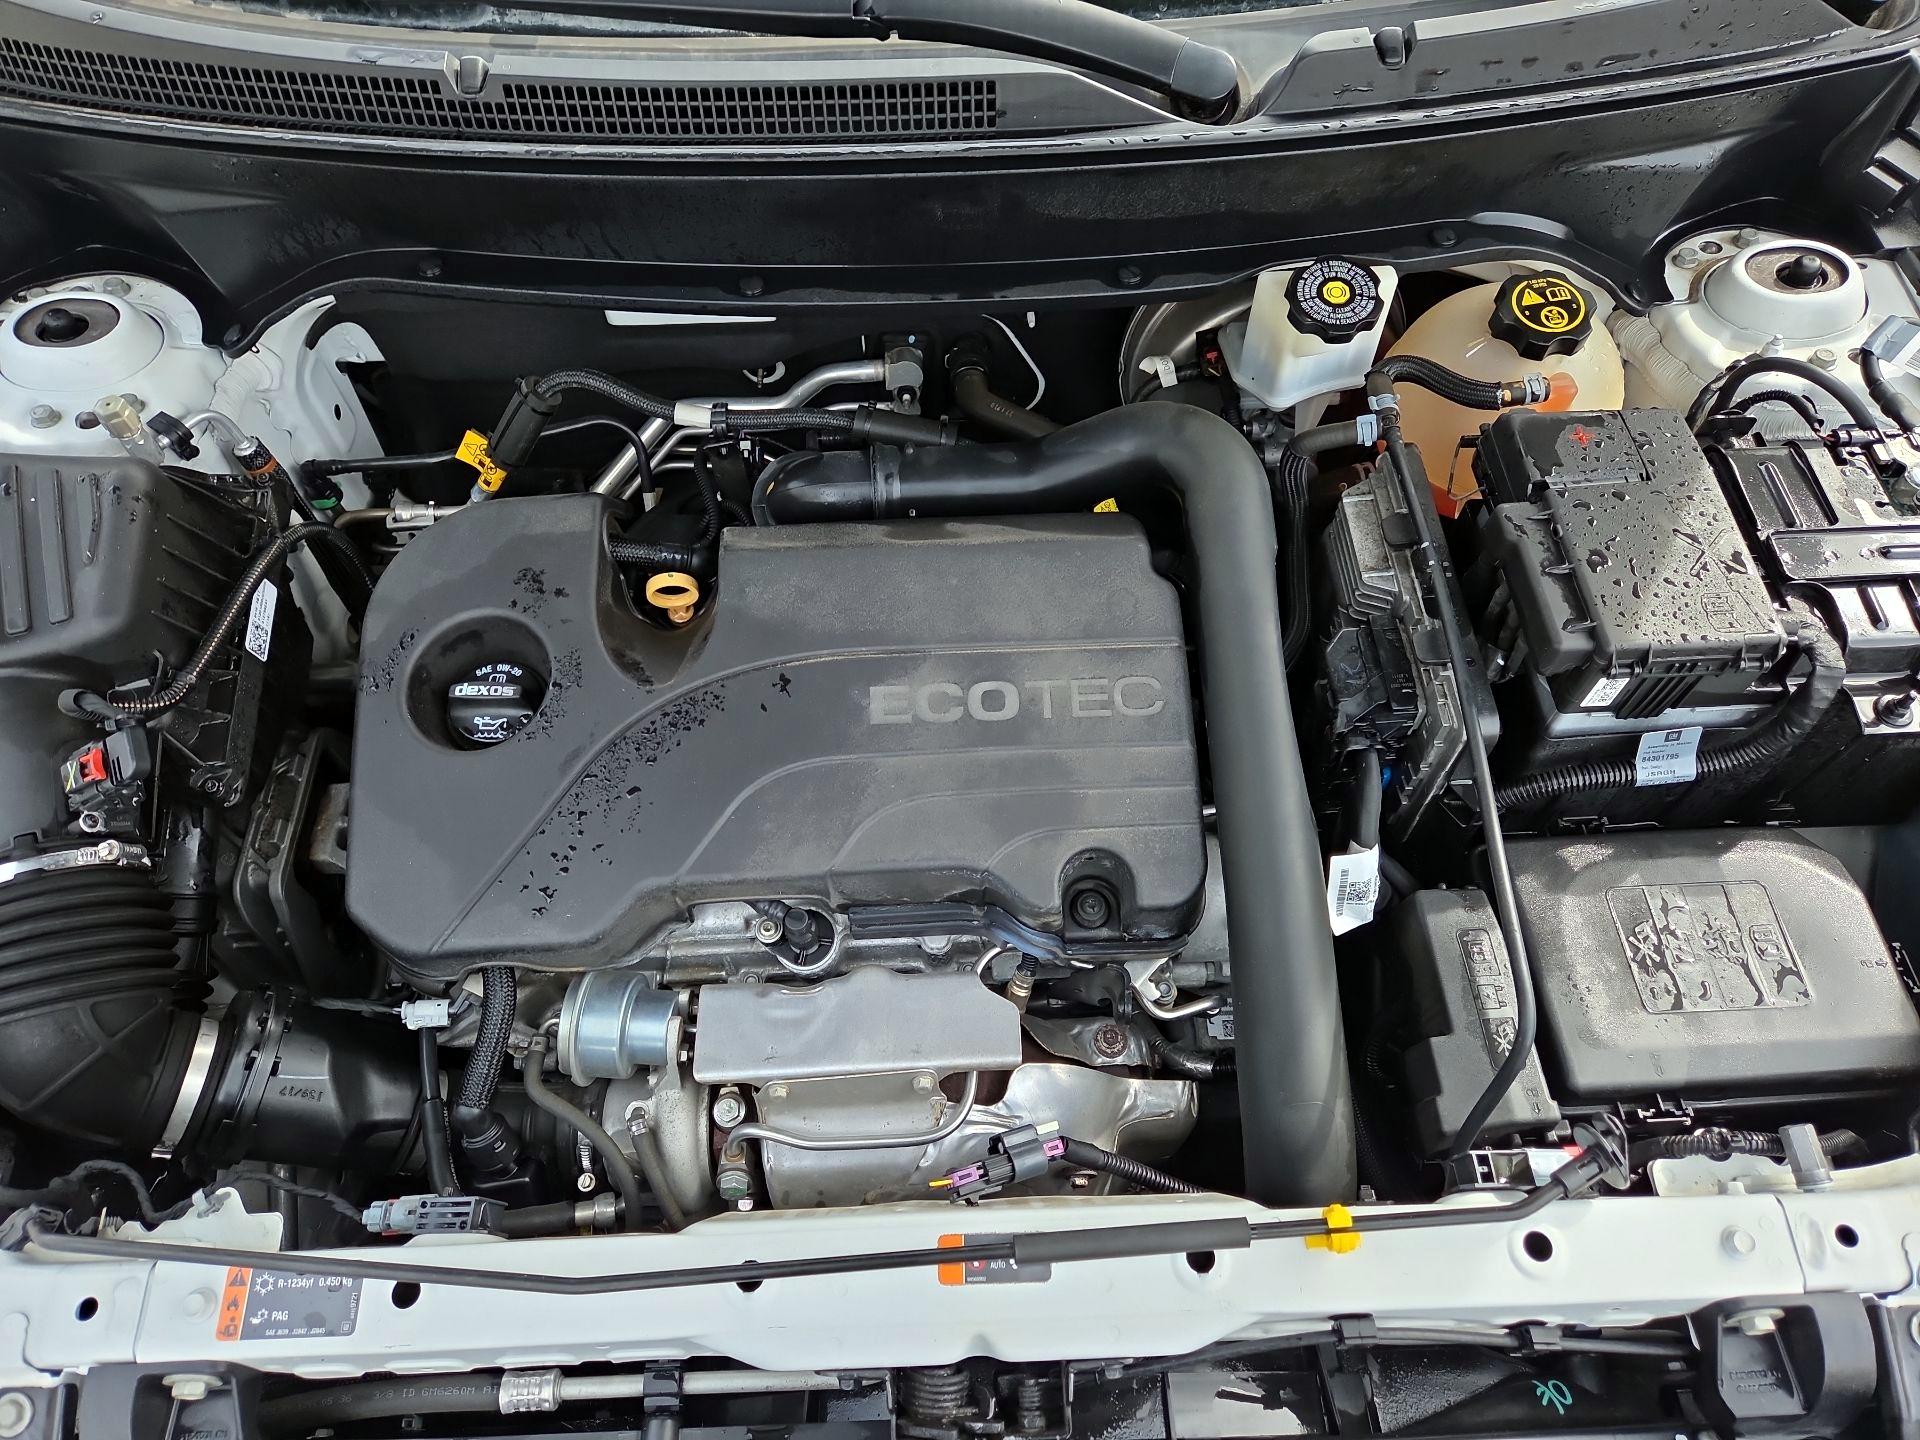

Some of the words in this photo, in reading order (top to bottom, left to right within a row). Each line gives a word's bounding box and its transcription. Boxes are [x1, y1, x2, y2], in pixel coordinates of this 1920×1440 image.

[475, 665, 493, 676] SAE
[497, 664, 523, 677] 0W-20
[455, 682, 517, 696] dexos
[869, 676, 1165, 725] ECOTEC
[1641, 752, 1680, 763] 84301795
[990, 1259, 1006, 1269] AUTO
[277, 1277, 314, 1289] R-1234yf
[318, 1276, 341, 1287] 0.450
[342, 1275, 353, 1288] kg
[271, 1310, 289, 1321] PAG
